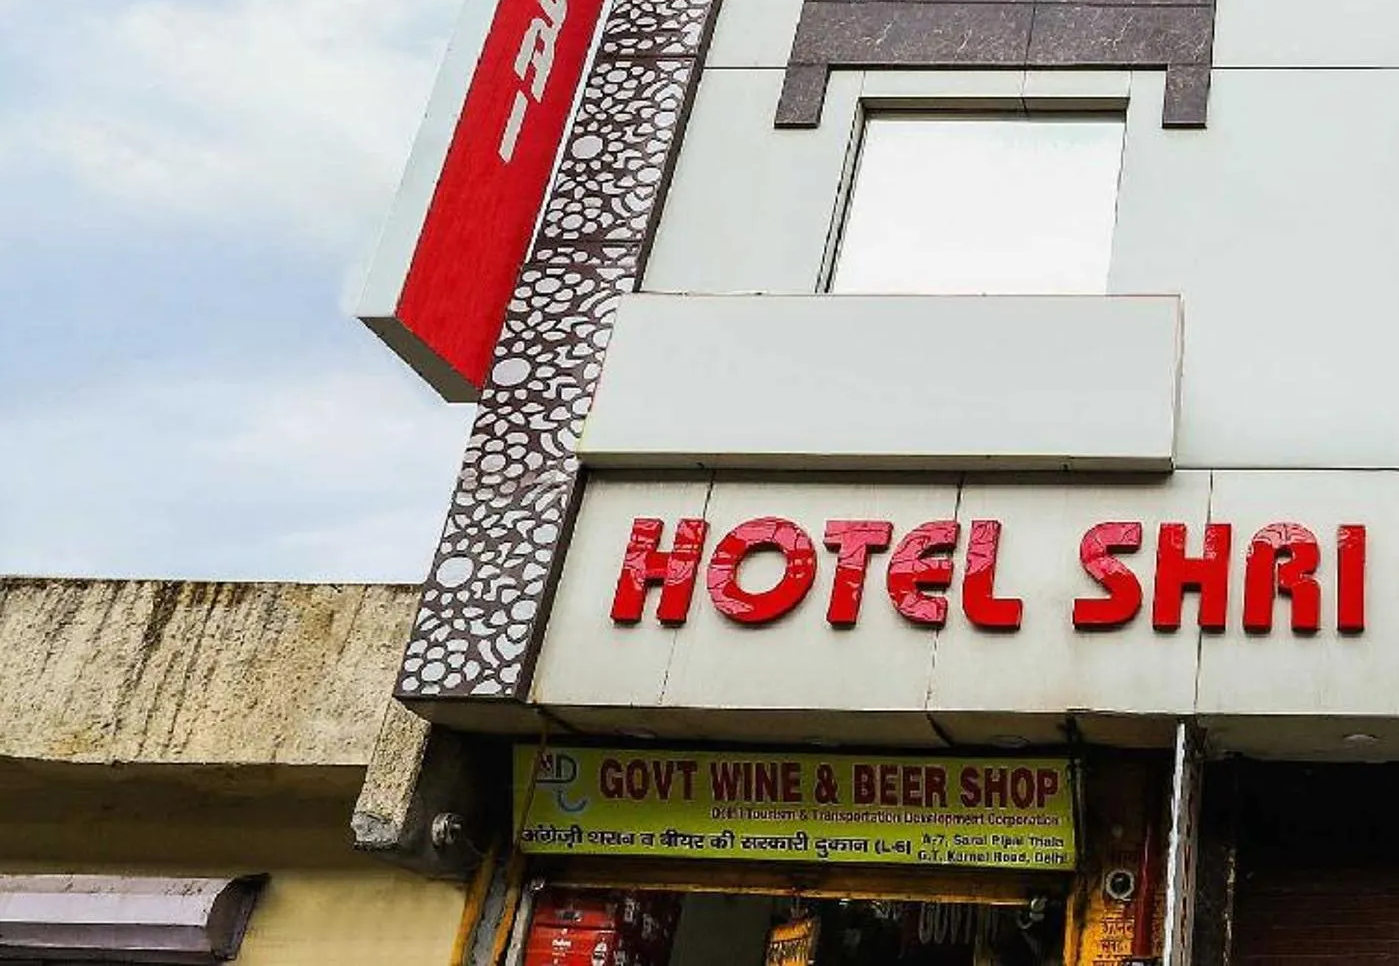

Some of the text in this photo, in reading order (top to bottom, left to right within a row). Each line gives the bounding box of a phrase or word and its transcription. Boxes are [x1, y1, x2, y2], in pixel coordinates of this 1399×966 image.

[609, 516, 1024, 631] HOTEL
[1071, 520, 1368, 635] SHRI
[600, 757, 699, 802] GOVT
[708, 761, 802, 804] WINE
[814, 763, 840, 805] &
[852, 763, 949, 809] BEER
[959, 766, 1060, 811] SHOP
[812, 809, 902, 825] Transportation
